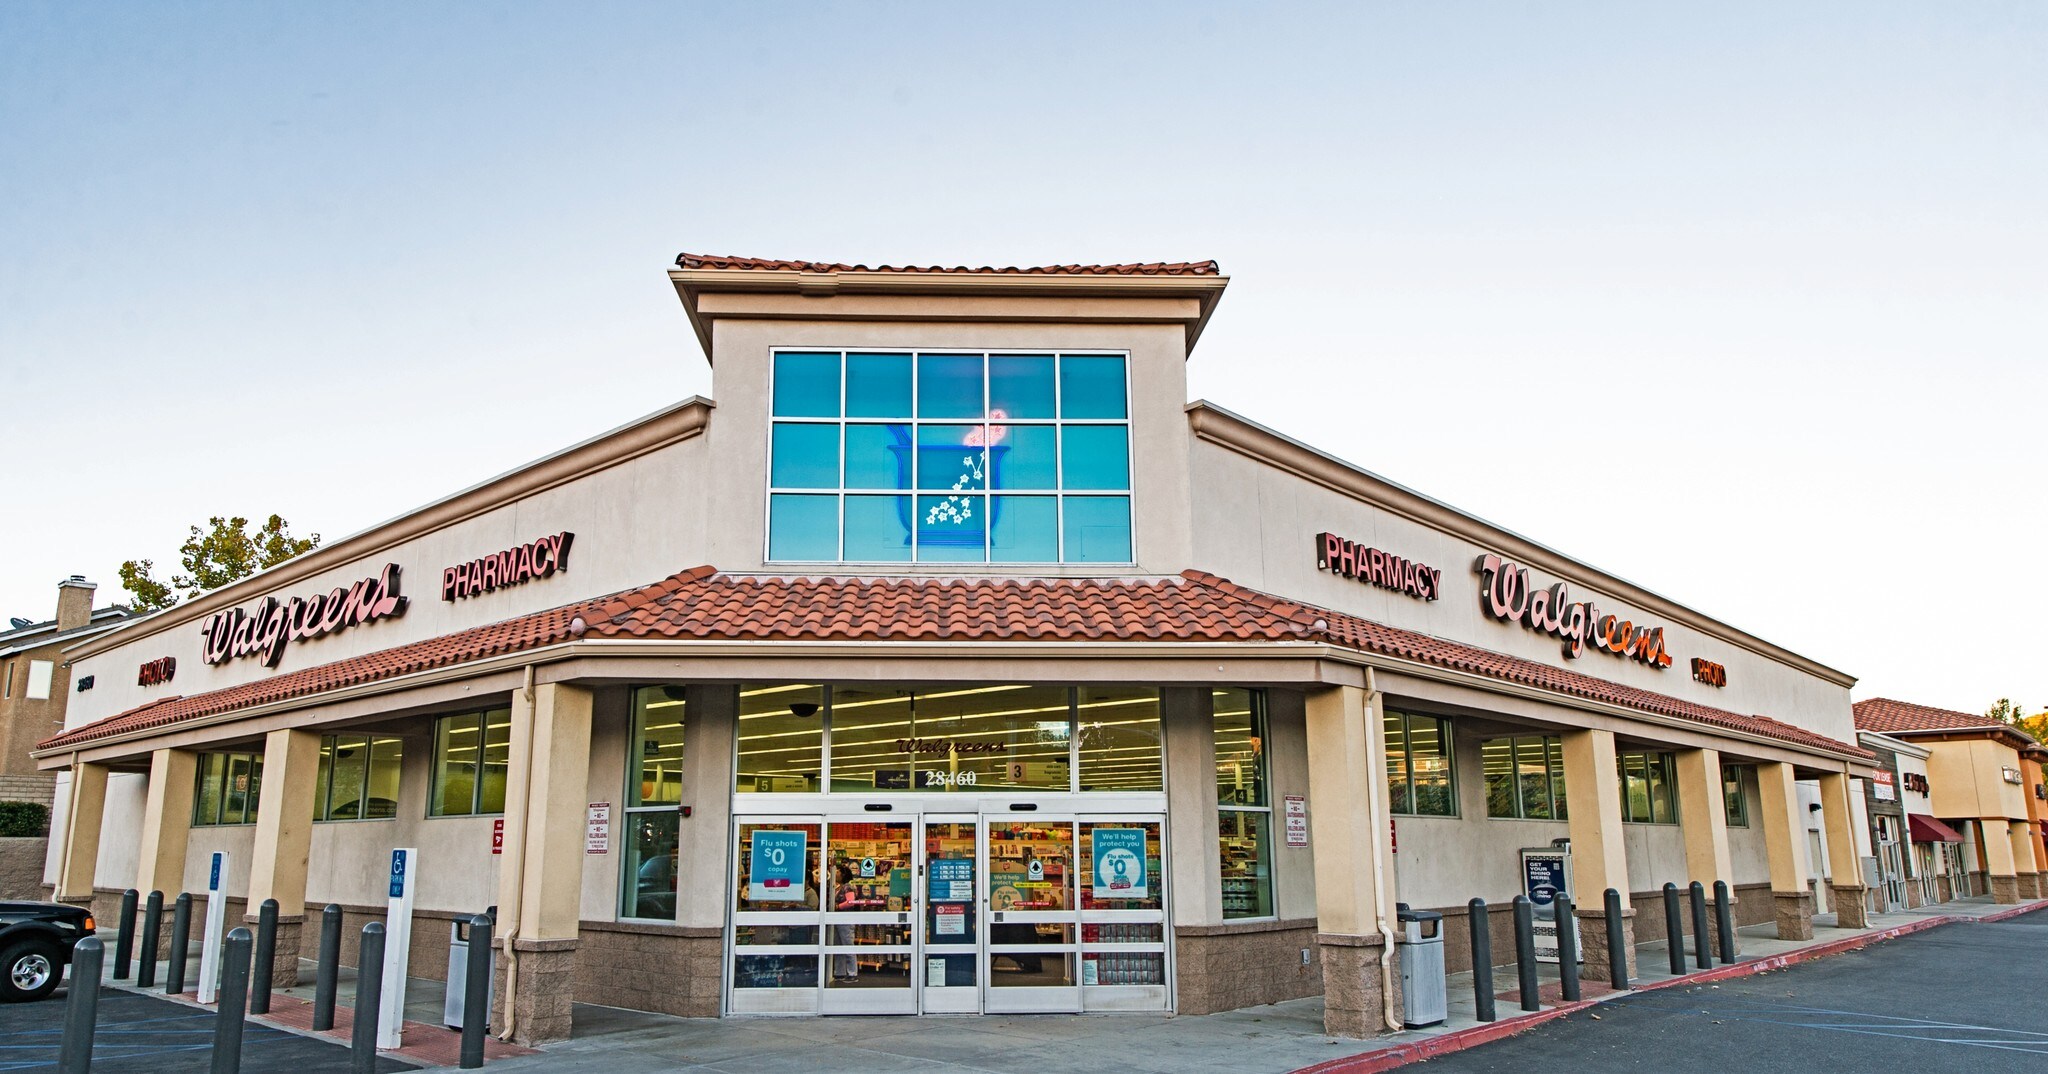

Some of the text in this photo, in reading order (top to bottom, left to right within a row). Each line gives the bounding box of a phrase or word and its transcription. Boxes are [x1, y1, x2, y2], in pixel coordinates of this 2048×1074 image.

[442, 532, 572, 602] PHARMACY
[1320, 532, 1441, 600] PHARMACY
[202, 563, 405, 667] Walgreens
[1477, 553, 1672, 669] Walgreens
[138, 656, 173, 687] PHOTO
[1694, 657, 1727, 687] PHOTO
[895, 738, 1008, 758] Walgreens
[925, 770, 977, 786] 28460
[1014, 765, 1022, 778] 3
[761, 780, 768, 791] 5
[1238, 791, 1244, 800] 4
[760, 839, 773, 847] Flu
[1121, 833, 1137, 841] help
[764, 847, 785, 866] $0
[1108, 859, 1126, 875] $0
